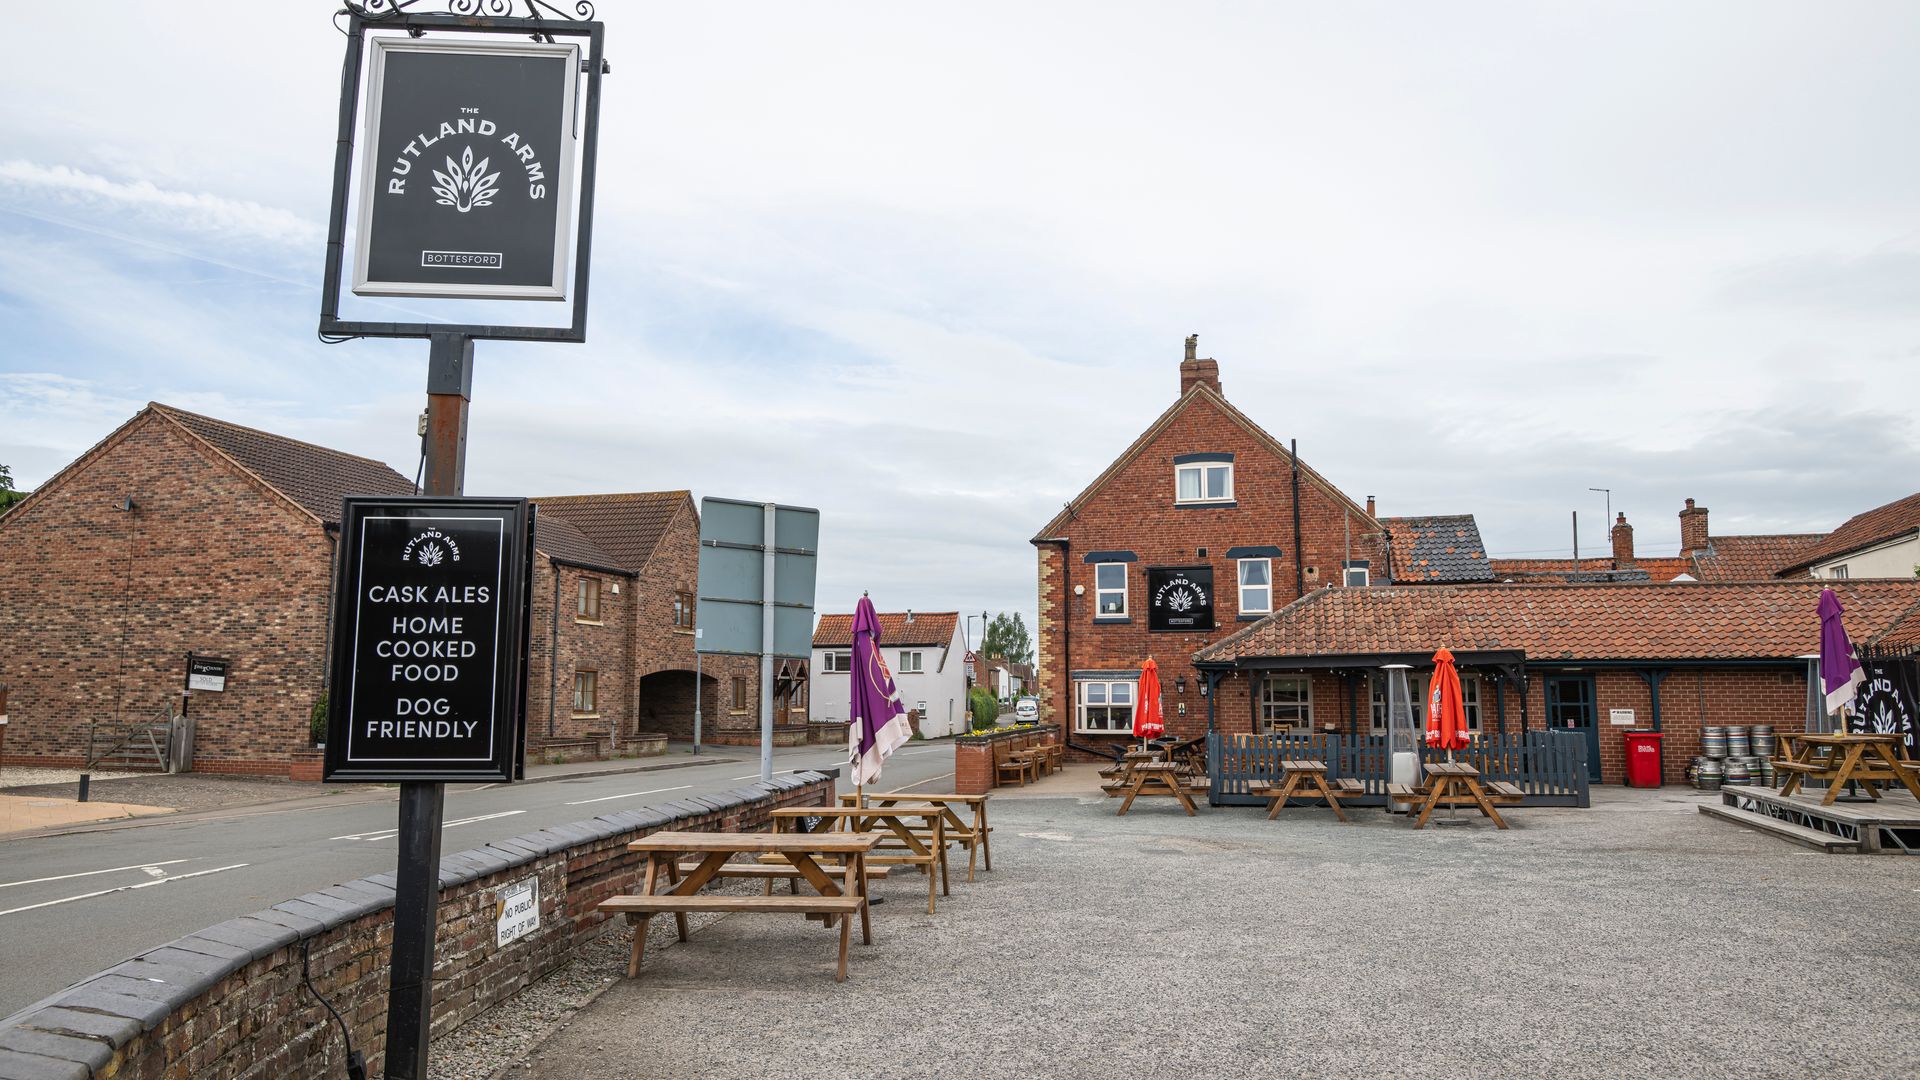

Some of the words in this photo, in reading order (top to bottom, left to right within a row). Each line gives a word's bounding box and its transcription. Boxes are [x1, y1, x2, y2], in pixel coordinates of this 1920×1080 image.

[388, 118, 496, 195] RUTLAND
[501, 132, 546, 200] ARMS
[427, 254, 497, 265] BOTTESFORD
[403, 531, 442, 561] RUTLAND
[443, 536, 460, 561] ARMS
[369, 586, 429, 603] CASK
[434, 586, 490, 603] ALES
[1155, 579, 1189, 607] RUTLAND
[1190, 582, 1207, 607] ARMS
[392, 617, 463, 634] HOME
[376, 641, 476, 658] COOKED
[391, 664, 459, 682] FOOD
[397, 698, 450, 715] DOG
[367, 721, 478, 738] FRIENDLY
[505, 907, 513, 919] NO
[514, 899, 532, 916] PUBLIC
[501, 925, 516, 941] RIGHT
[518, 921, 525, 932] OF
[526, 916, 536, 928] WAY
